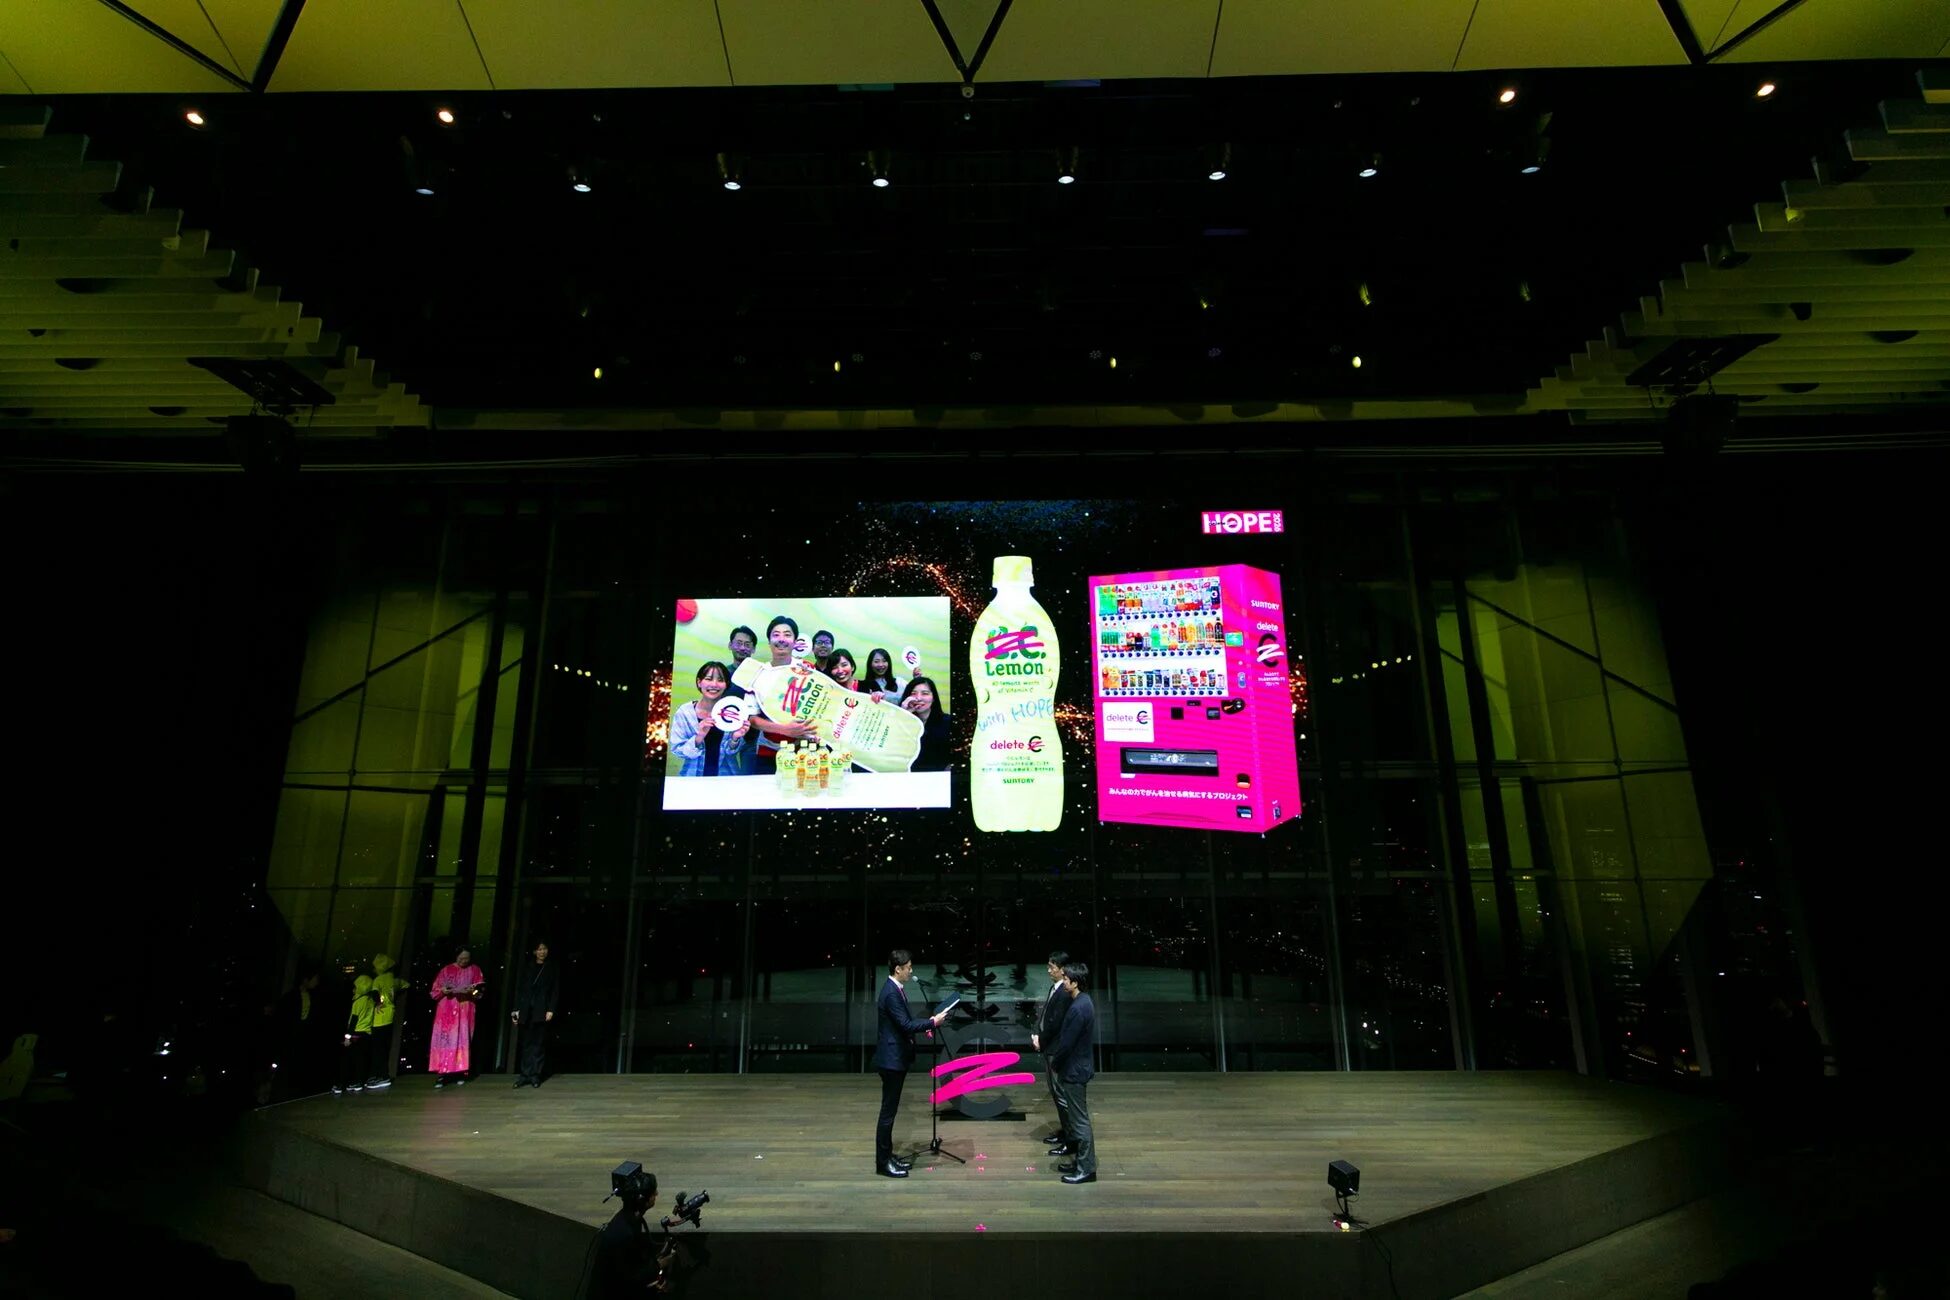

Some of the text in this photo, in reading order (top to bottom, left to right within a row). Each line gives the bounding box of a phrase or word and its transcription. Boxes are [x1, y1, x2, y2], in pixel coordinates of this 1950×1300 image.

[1203, 513, 1272, 533] HOPE
[1251, 600, 1280, 611] SUNTORY
[1256, 622, 1279, 632] delete
[985, 661, 1044, 676] Lemon
[979, 698, 1055, 731] with HOPE
[1106, 714, 1134, 722] delete
[833, 710, 851, 739] delete
[990, 740, 1025, 750] delete
